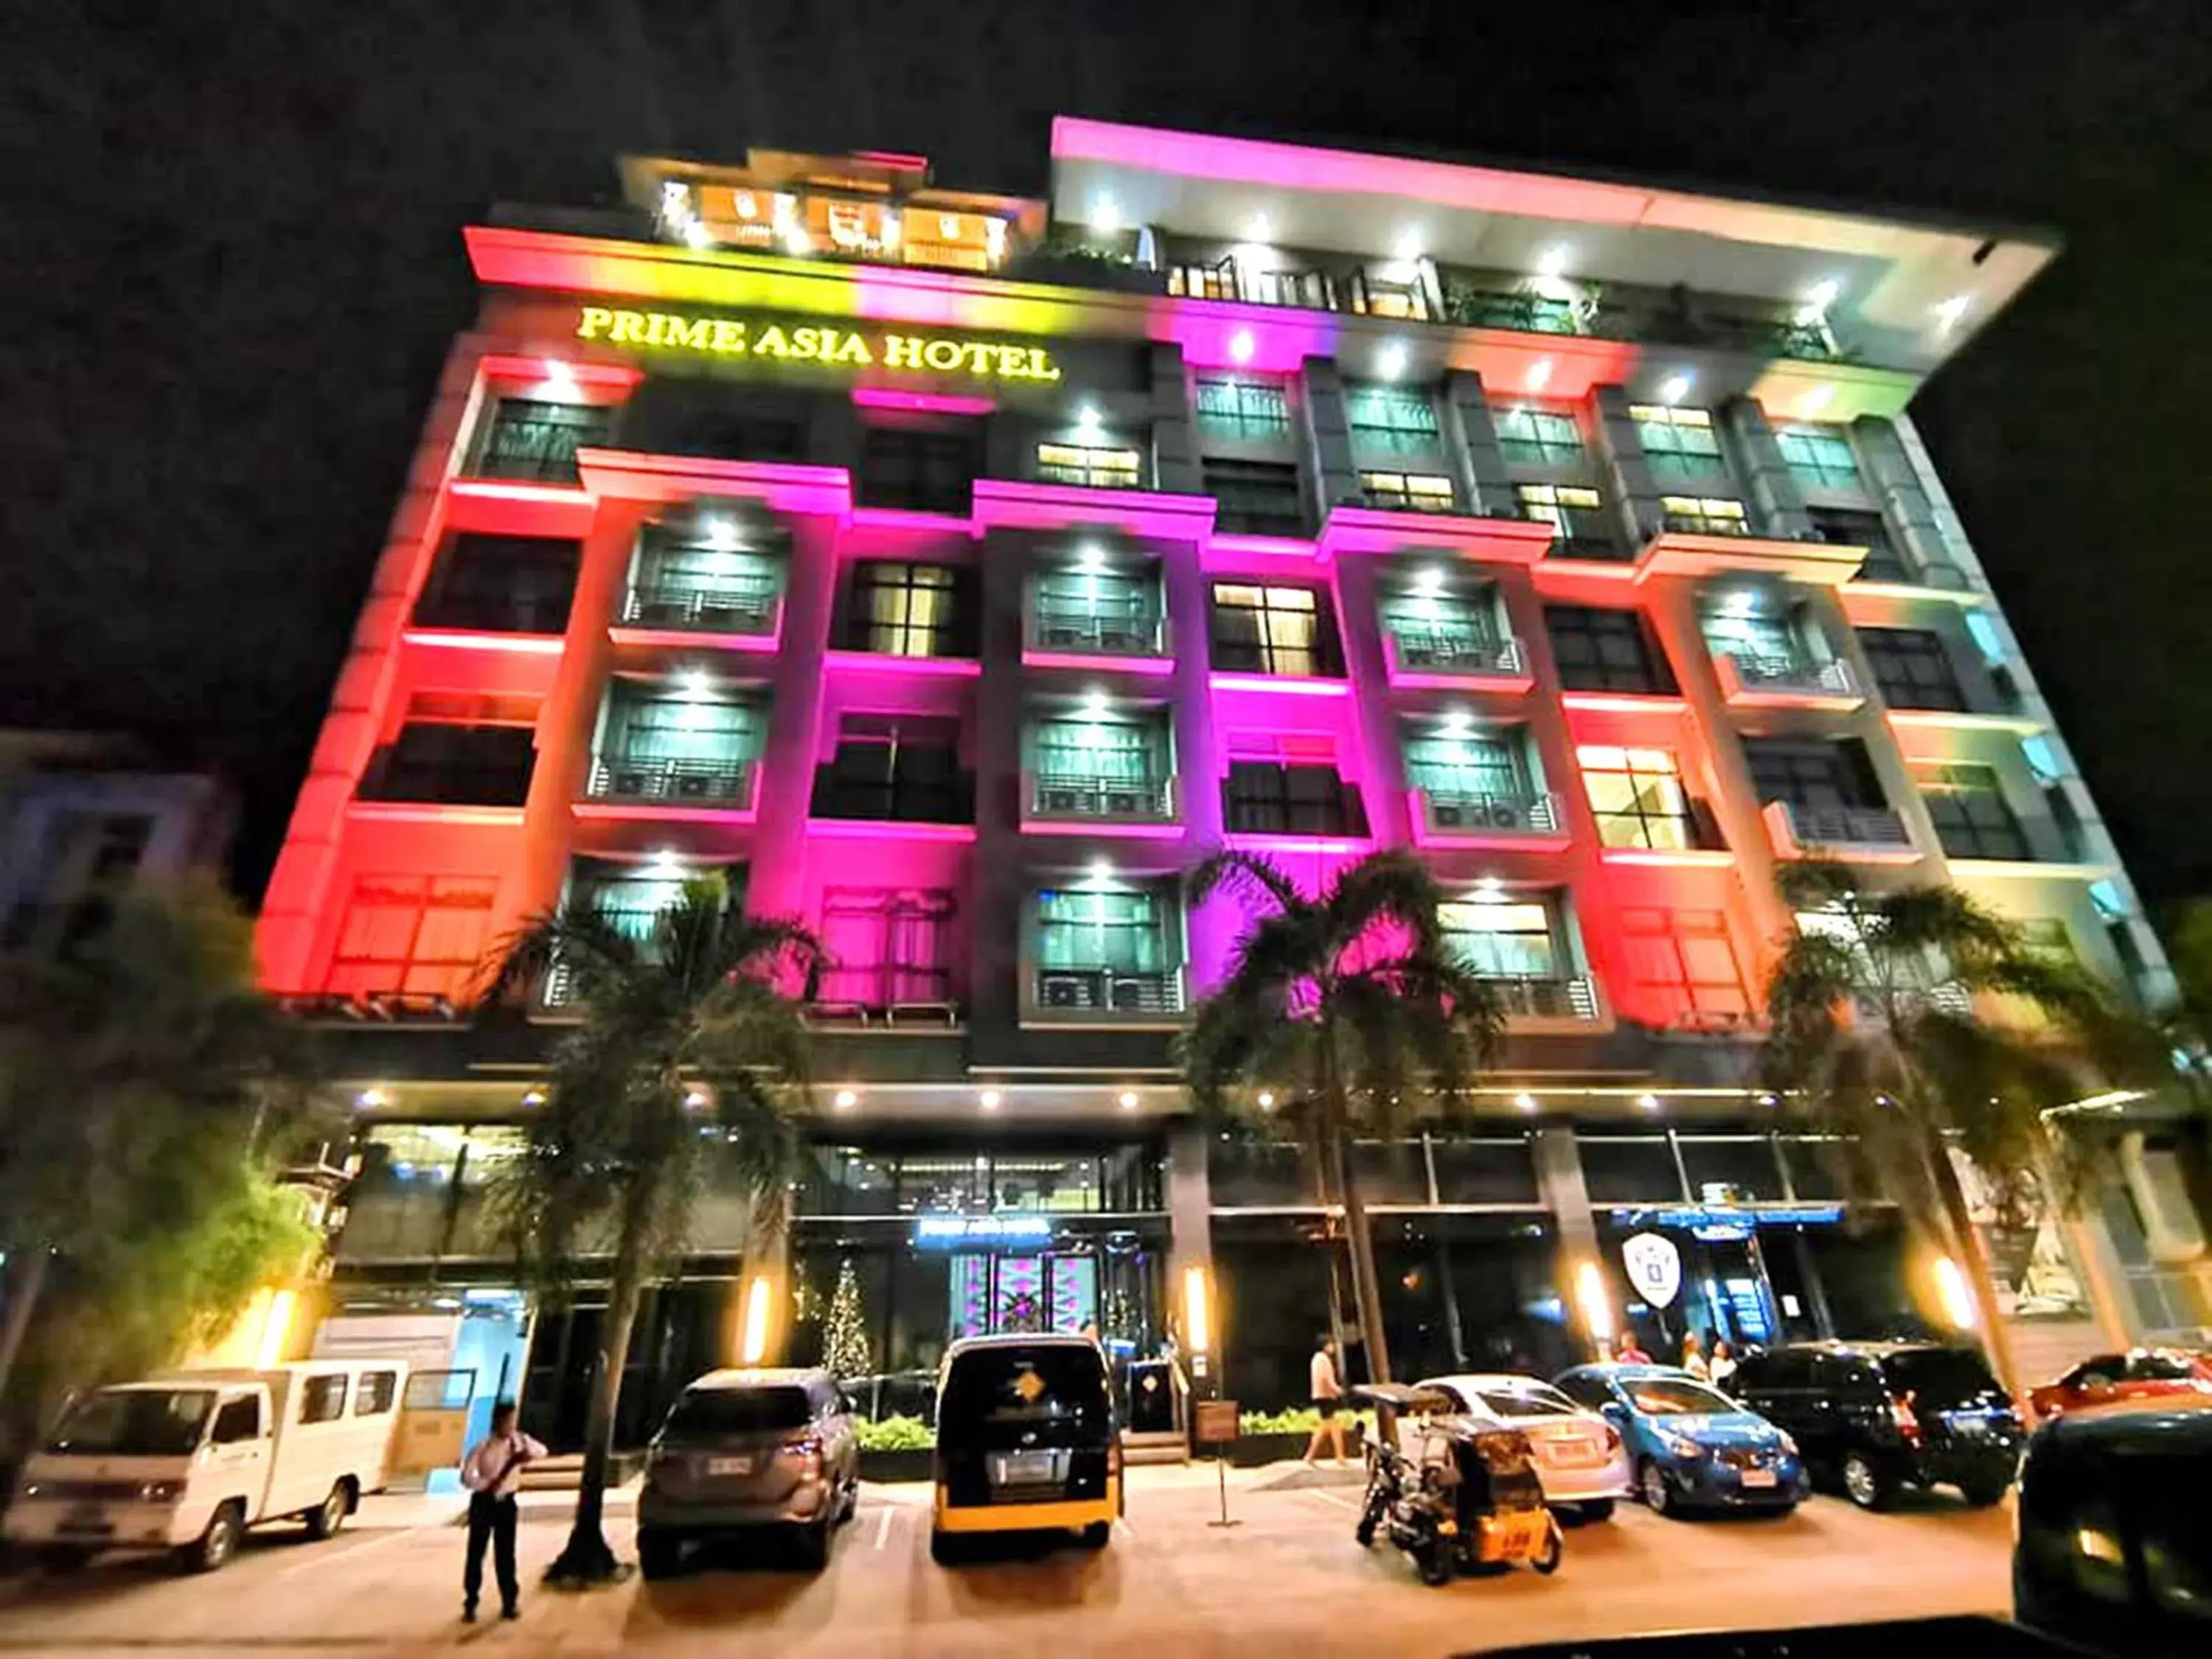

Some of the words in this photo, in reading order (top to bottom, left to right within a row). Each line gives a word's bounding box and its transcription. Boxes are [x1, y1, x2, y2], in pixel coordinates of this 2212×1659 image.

[577, 307, 745, 352] PRIME
[753, 326, 872, 364] ASIA
[883, 335, 1061, 380] HOTEL
